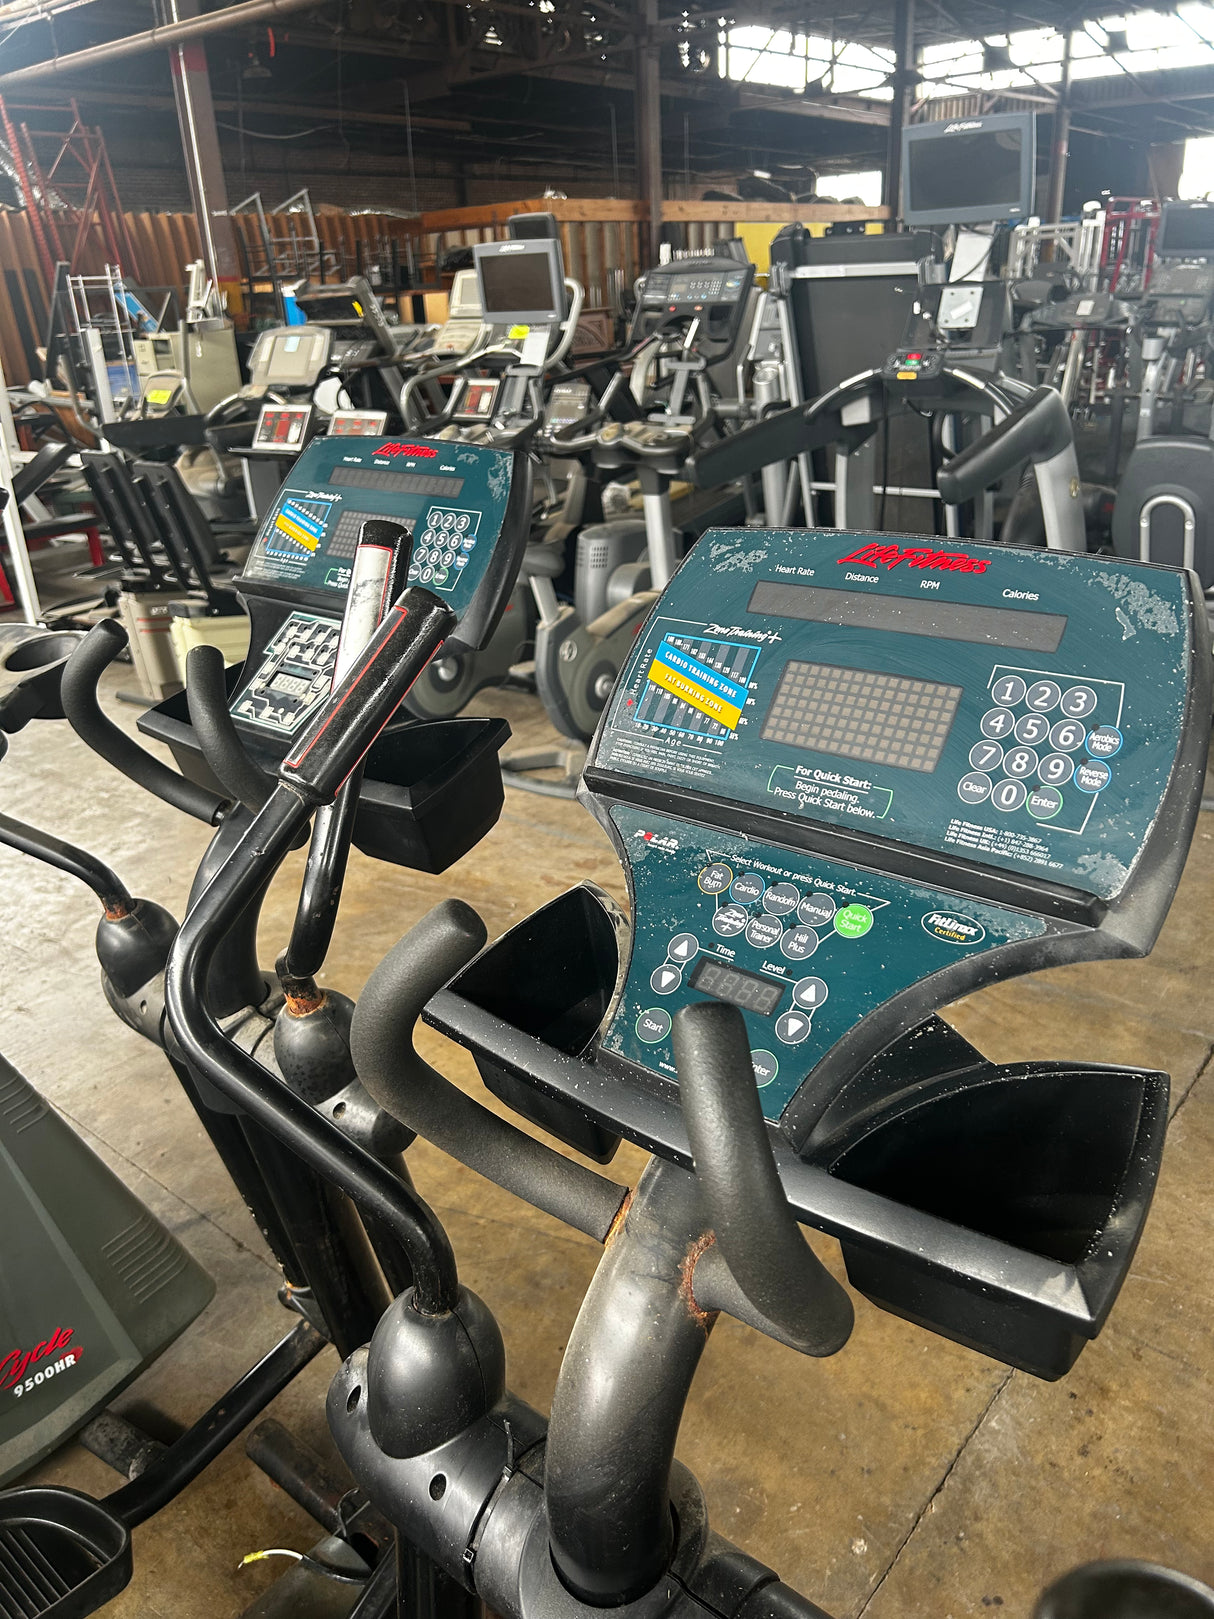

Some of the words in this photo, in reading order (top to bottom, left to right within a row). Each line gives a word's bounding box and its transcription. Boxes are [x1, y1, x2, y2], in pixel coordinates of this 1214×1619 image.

[430, 514, 439, 526] 1
[443, 516, 453, 527] 2
[457, 517, 467, 528] 3
[424, 530, 432, 542] 4
[436, 533, 446, 544] 5
[450, 535, 460, 547] 6
[416, 550, 426, 560] 7
[430, 549, 439, 560] 8
[443, 550, 453, 564] 9
[422, 569, 432, 580] 0
[776, 564, 796, 575] Heart
[797, 567, 815, 577] Rate
[844, 572, 879, 584] Distance
[920, 580, 940, 590] RPM
[1002, 588, 1040, 602] Calories
[630, 668, 642, 696] Heart
[640, 648, 653, 669] Rate
[665, 651, 688, 670] CARDIO
[689, 664, 719, 690] TRAINING
[720, 683, 738, 698] ZONE
[664, 673, 676, 686] FAT
[676, 678, 705, 702] BURNING
[705, 695, 724, 714] ZONE
[1001, 682, 1014, 700] 1
[1034, 686, 1052, 706] 2
[1070, 692, 1088, 712] 3
[990, 714, 1006, 733] 4
[1023, 720, 1042, 738] 5
[1058, 726, 1076, 746] 6
[664, 737, 682, 747] Age
[1090, 732, 1120, 746] Aerobics
[1092, 742, 1112, 752] Mode
[979, 746, 996, 765] 7
[1012, 752, 1030, 772] 8
[1048, 758, 1065, 778] 9
[796, 764, 812, 776] For
[813, 769, 842, 784] Quick
[842, 776, 872, 790] Start:
[1080, 766, 1110, 780] Reverse
[1080, 776, 1102, 788] Mode
[795, 780, 820, 794] Begin
[820, 787, 860, 805] pedaling.
[962, 781, 988, 794] Clear
[1001, 784, 1018, 805] 0
[1030, 795, 1059, 808] Enter
[774, 786, 797, 800] Press
[798, 792, 822, 806] Quick
[823, 798, 846, 811] Start
[846, 804, 876, 819] below.
[948, 824, 960, 832] Life
[960, 826, 981, 837] Fitness
[950, 818, 962, 826] Life
[962, 820, 984, 830] Fitness
[946, 830, 958, 838] Life
[958, 832, 979, 843] Fitness
[944, 836, 956, 844] Life
[956, 838, 977, 849] Fitness
[976, 844, 992, 852] Asia
[710, 870, 724, 880] Fat
[730, 854, 751, 866] Select
[753, 860, 784, 876] Workout
[783, 870, 793, 878] or
[792, 872, 814, 884] press
[813, 878, 834, 890] Quick
[704, 878, 722, 888] Burn
[734, 882, 760, 896] Cardio
[765, 891, 796, 907] Random
[800, 902, 831, 918] Manual
[842, 910, 867, 923] Quick
[752, 920, 780, 936] Personal
[840, 920, 862, 932] Start
[934, 926, 966, 940] Certified
[750, 930, 773, 943] Trainer
[794, 933, 808, 944] Hill
[716, 944, 736, 958] Time
[788, 942, 806, 954] Plus
[762, 960, 786, 975] Level
[643, 1018, 664, 1034] Start
[752, 1061, 771, 1076] nter
[14, 1354, 76, 1398] 9500HR
